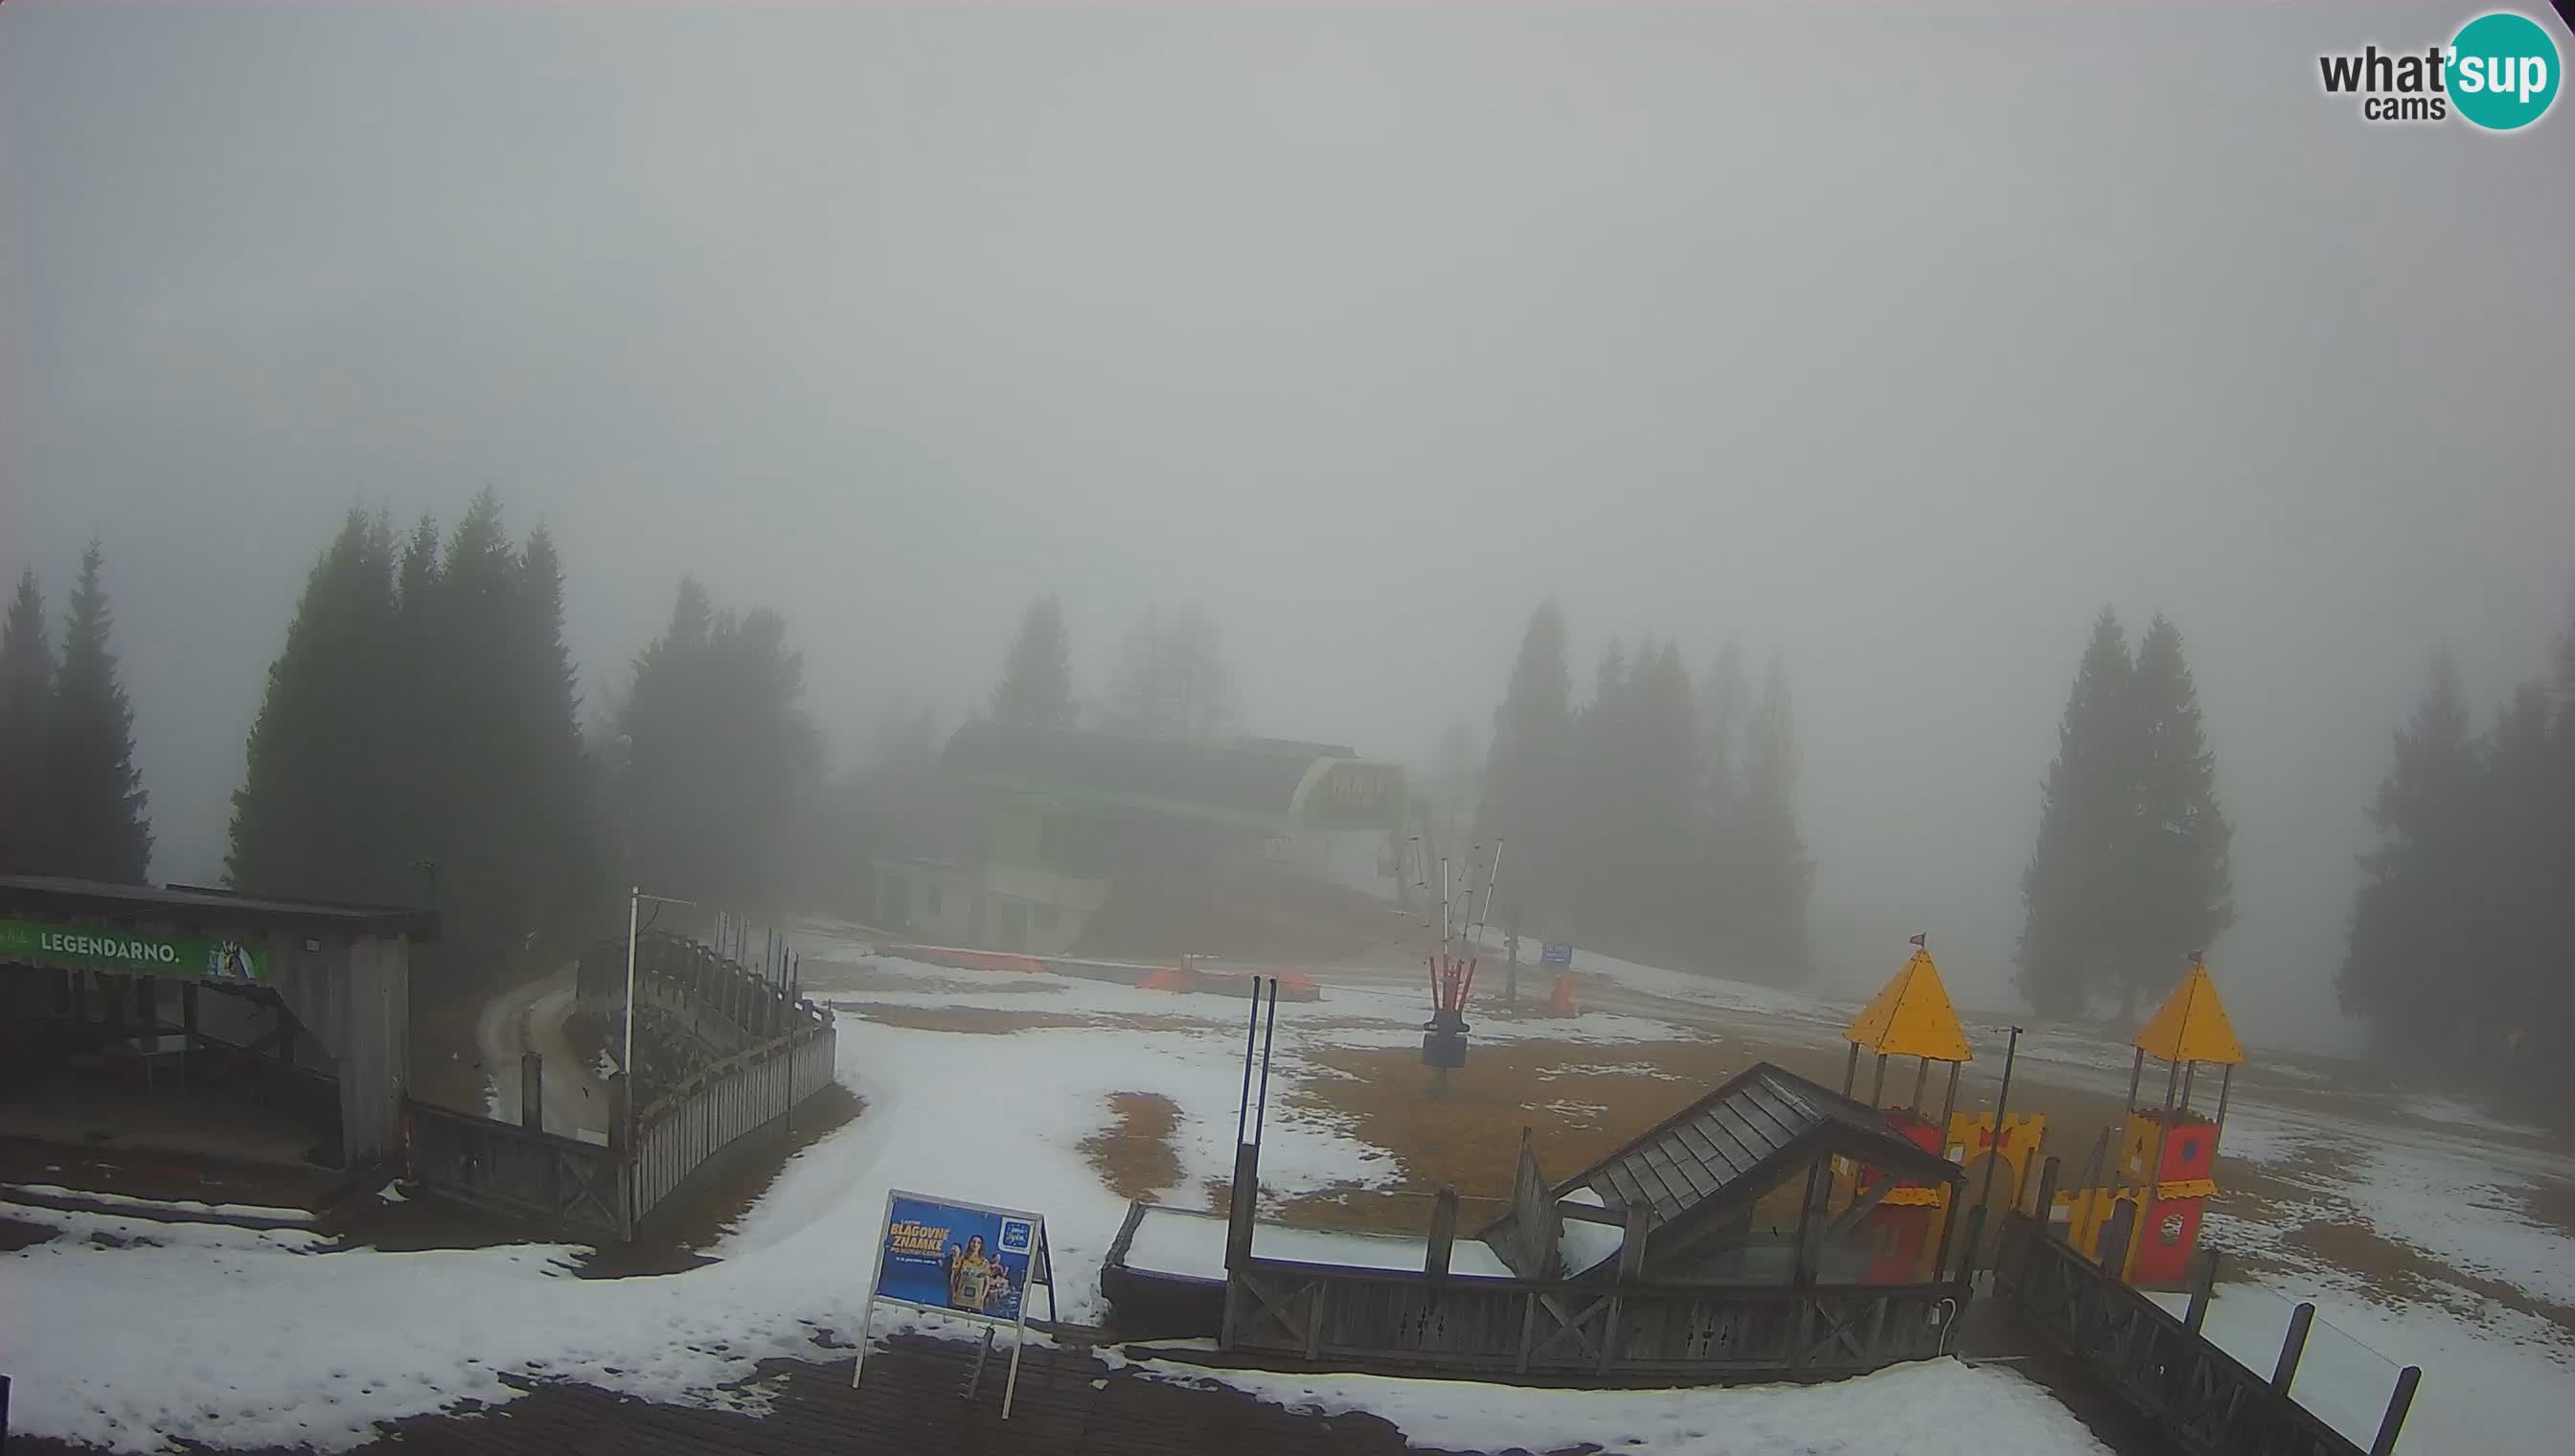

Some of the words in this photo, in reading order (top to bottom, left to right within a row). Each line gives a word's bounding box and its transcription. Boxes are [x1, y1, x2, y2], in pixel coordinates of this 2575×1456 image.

[41, 932, 181, 964] LEGENDARNO.
[891, 1223, 950, 1241] BLAGOVNE
[893, 1236, 944, 1251] ZNAMKE
